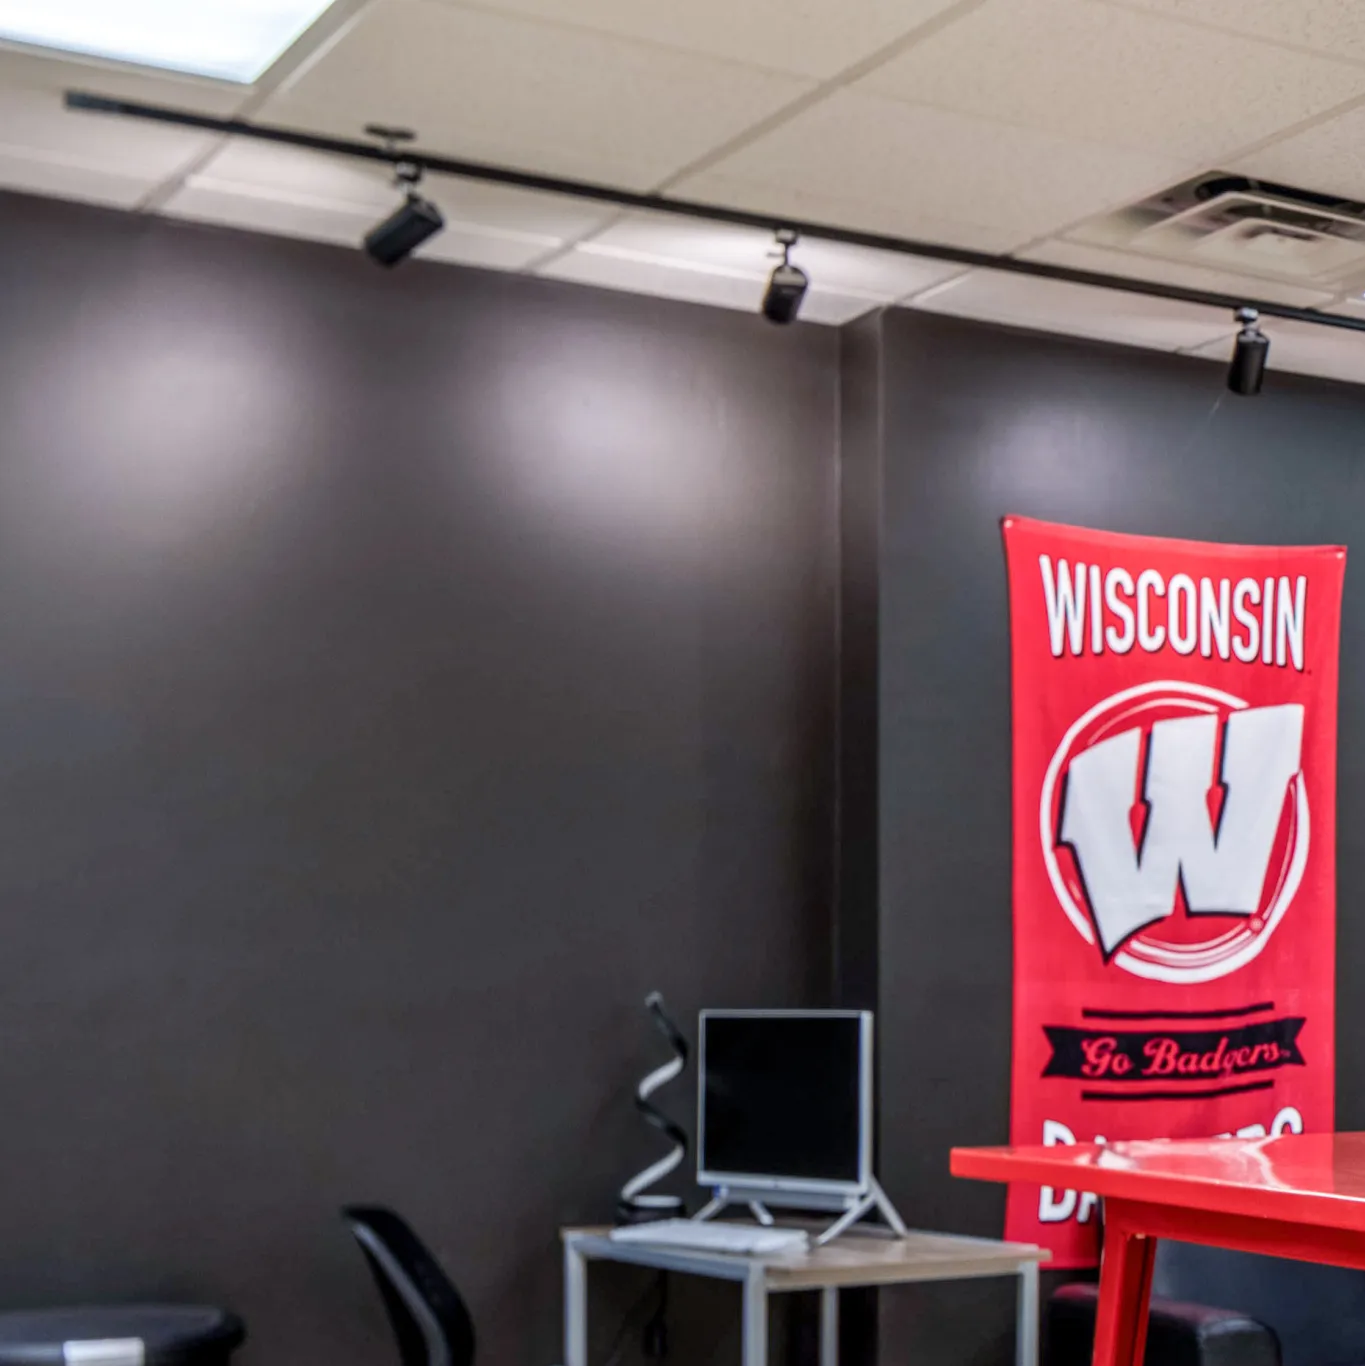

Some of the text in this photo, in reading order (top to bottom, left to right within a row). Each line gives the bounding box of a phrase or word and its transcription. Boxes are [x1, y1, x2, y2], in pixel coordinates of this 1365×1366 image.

[1039, 554, 1307, 671] WISCONSIN
[1057, 704, 1304, 965] W
[1081, 1036, 1281, 1078] Go Badgers
